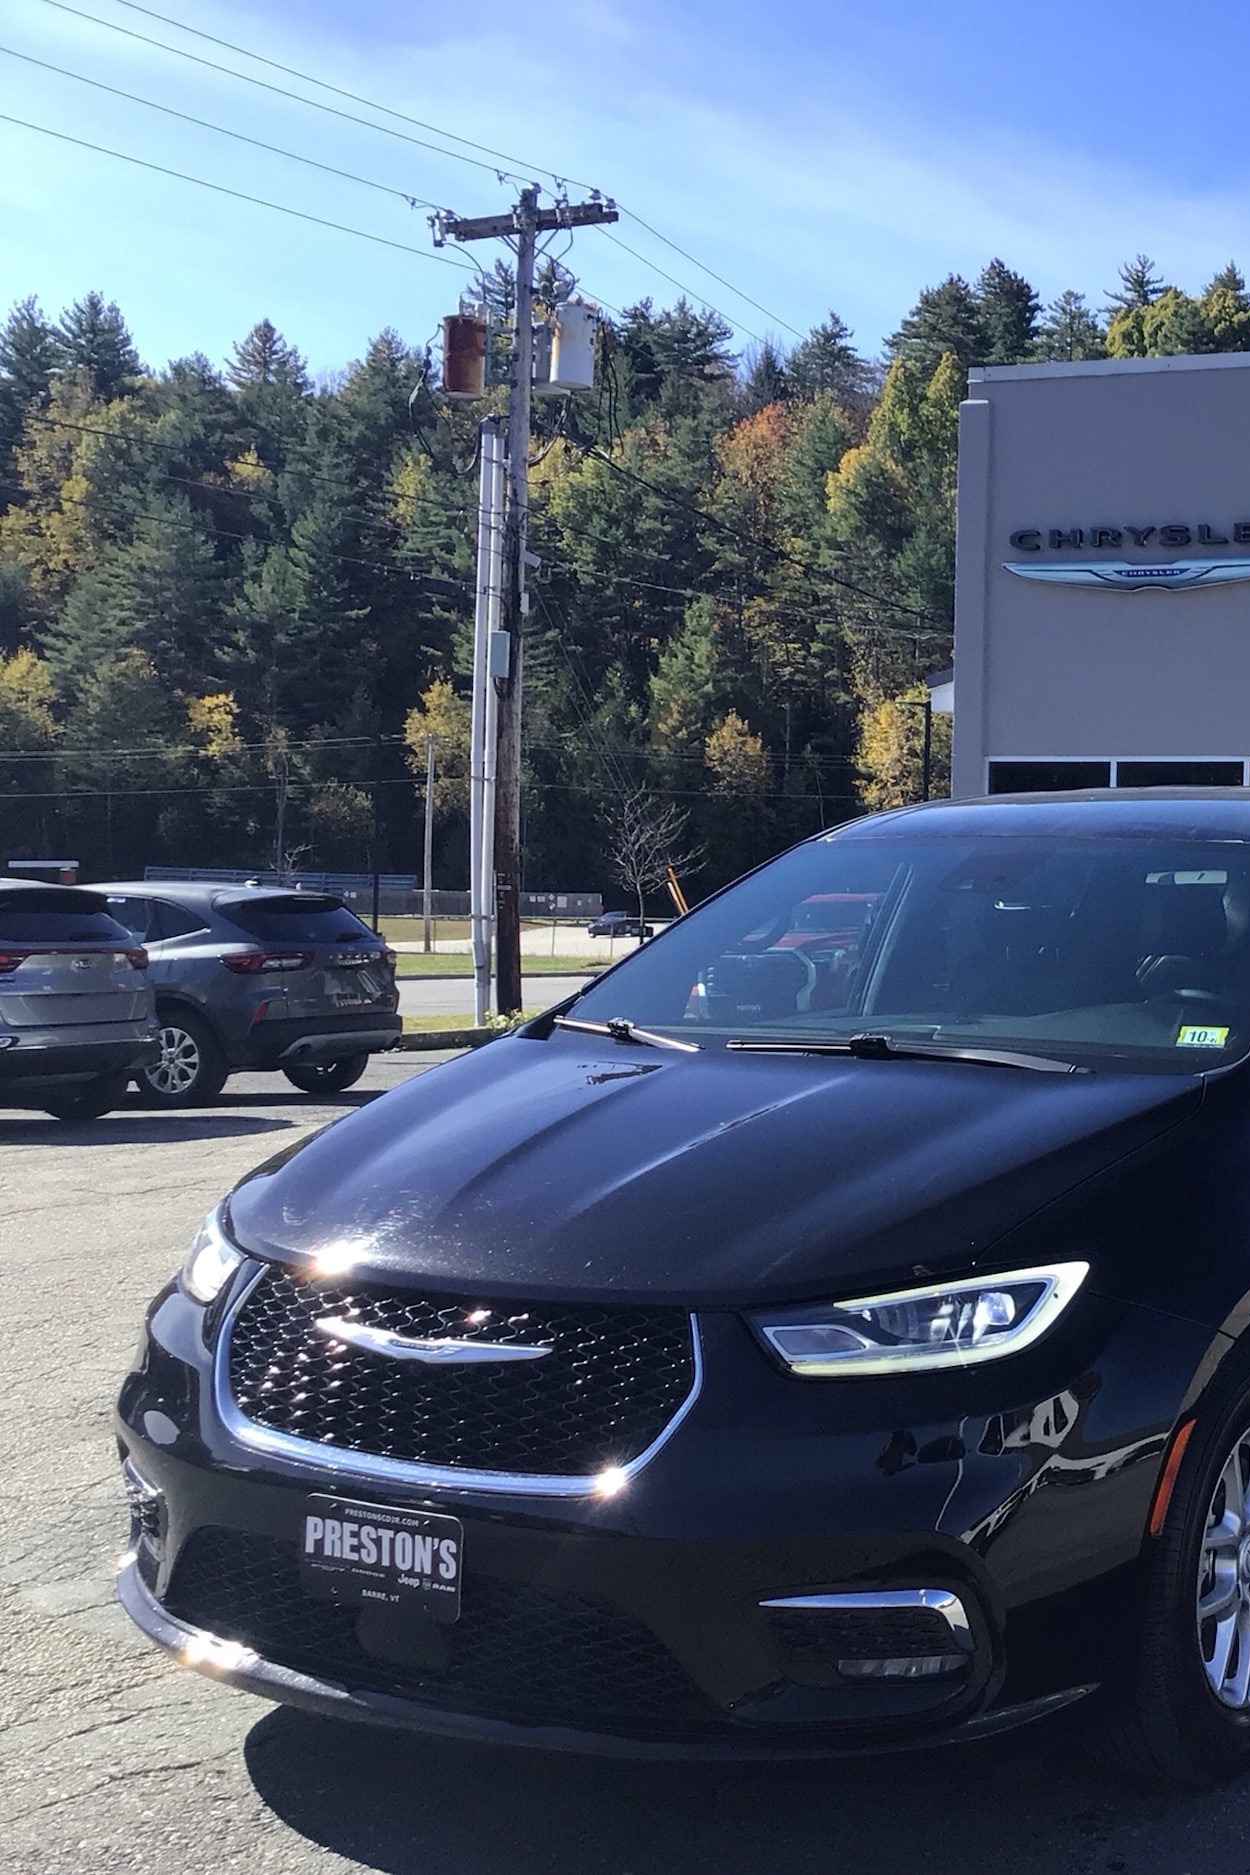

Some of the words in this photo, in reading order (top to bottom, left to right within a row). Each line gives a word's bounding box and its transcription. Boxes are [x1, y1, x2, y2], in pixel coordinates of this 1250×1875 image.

[1189, 1030, 1208, 1043] 10
[305, 1515, 457, 1580] PRESTON'S
[397, 1573, 420, 1588] Jeep
